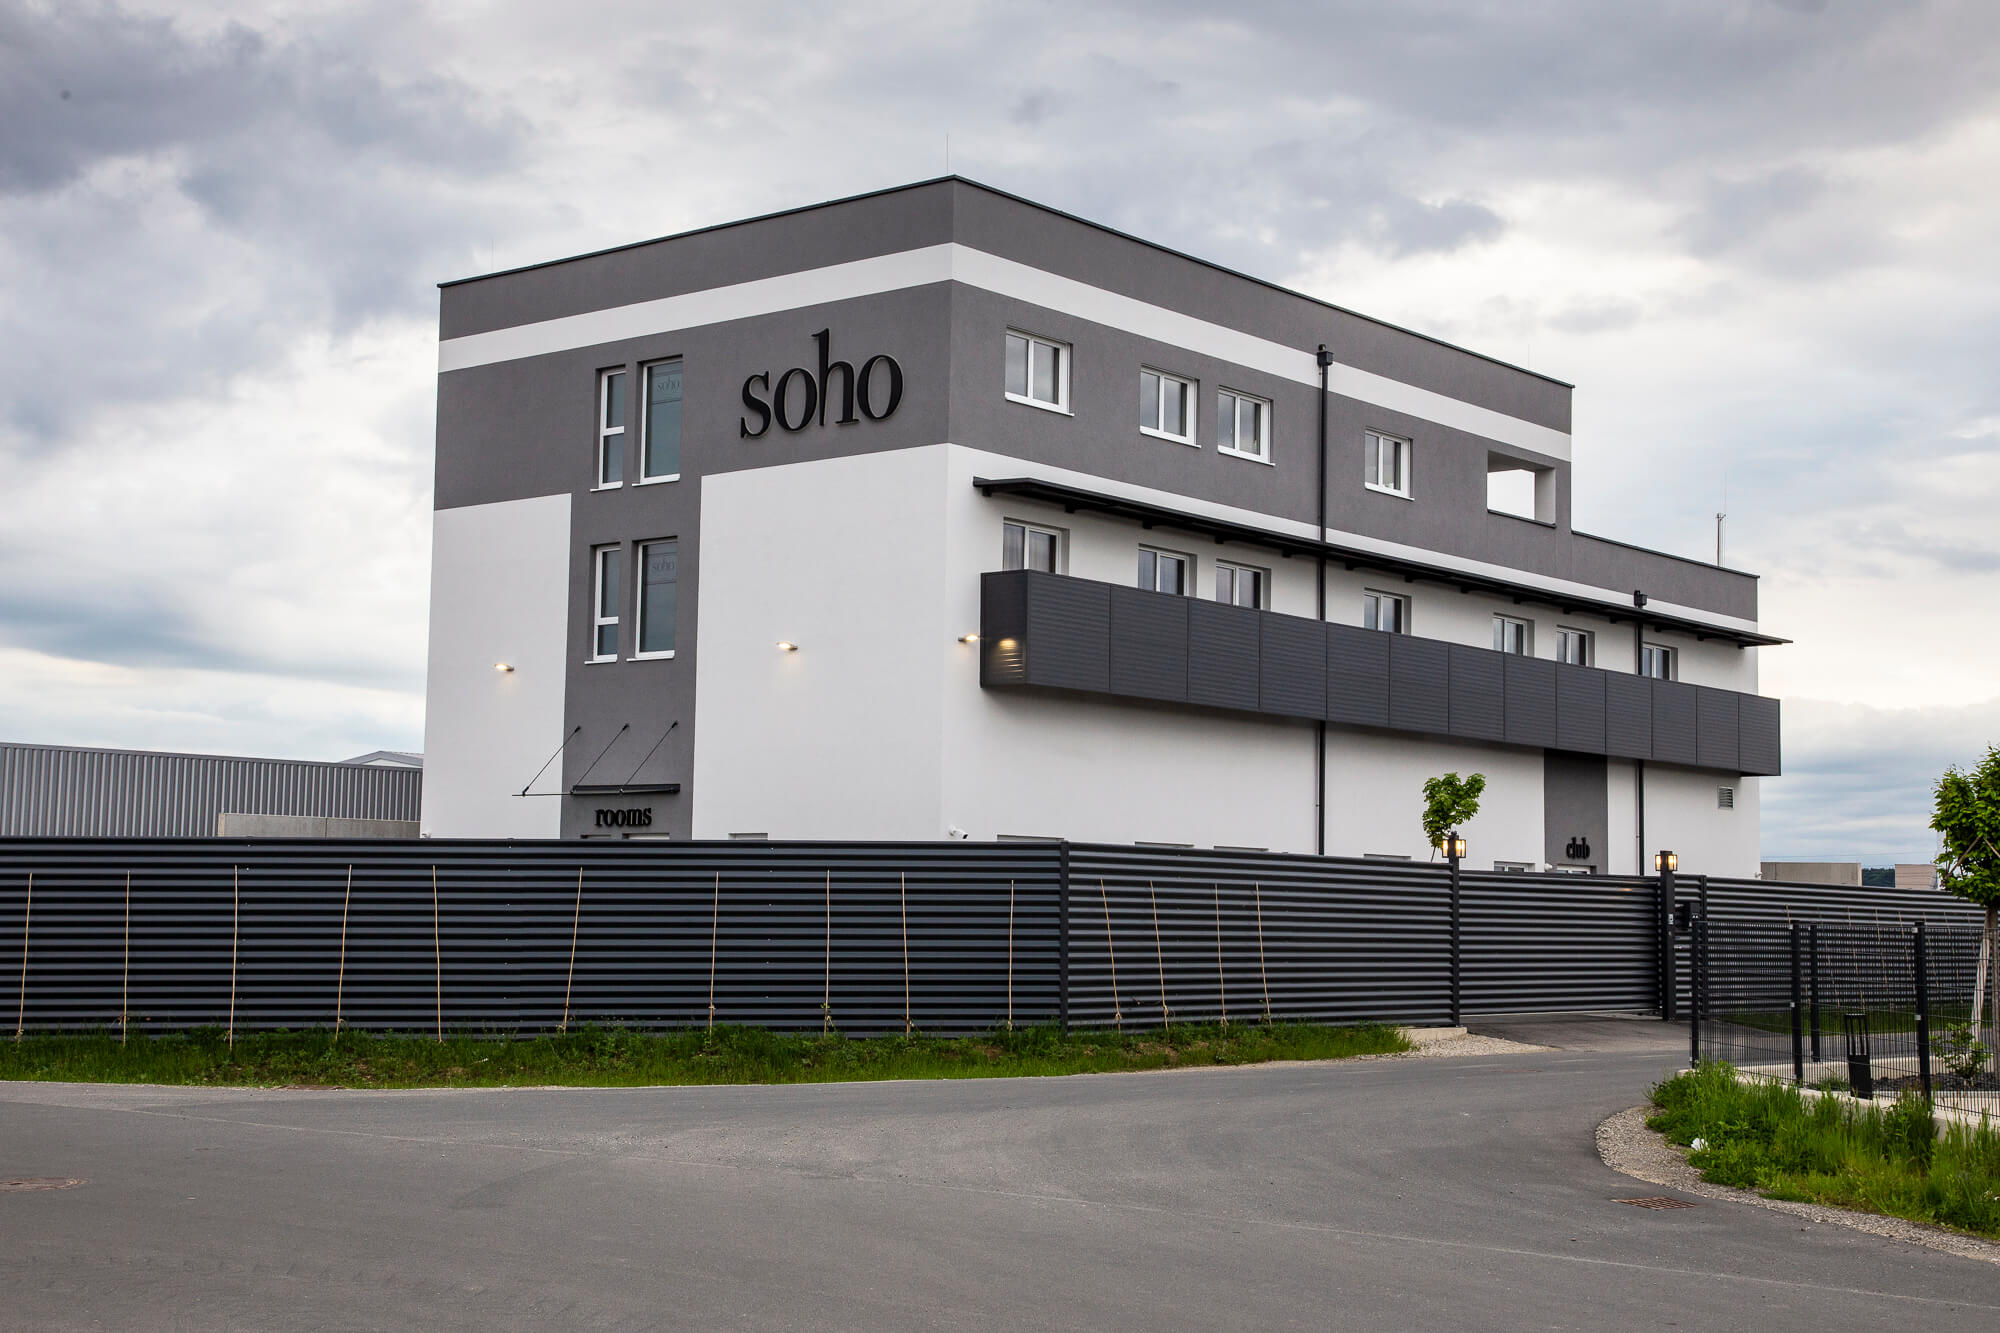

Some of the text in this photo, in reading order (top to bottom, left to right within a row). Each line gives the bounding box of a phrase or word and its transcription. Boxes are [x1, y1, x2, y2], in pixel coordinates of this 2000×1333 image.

[740, 328, 904, 438] soho
[594, 807, 652, 827] rooms
[1566, 836, 1591, 859] club
